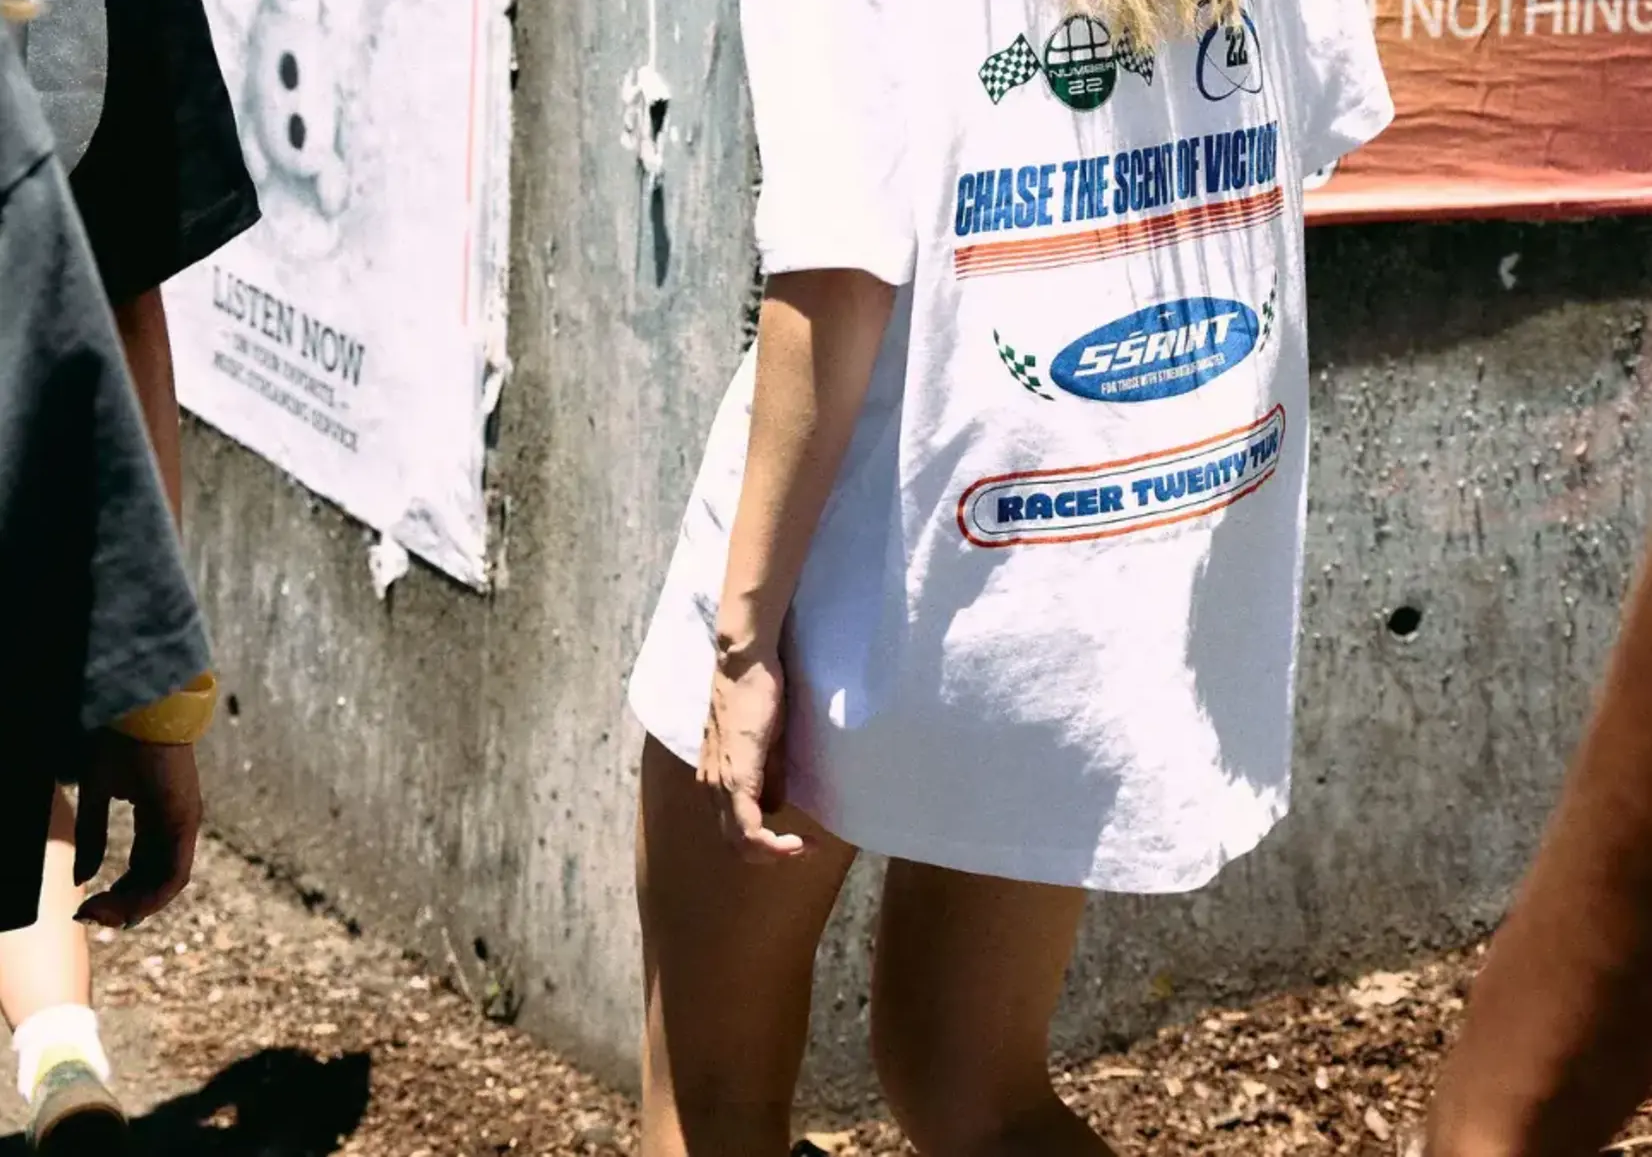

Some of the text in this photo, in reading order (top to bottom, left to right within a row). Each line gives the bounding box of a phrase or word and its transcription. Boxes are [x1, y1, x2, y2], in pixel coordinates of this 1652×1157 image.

[1225, 25, 1248, 68] 22
[1068, 77, 1103, 96] 22
[954, 163, 1057, 237] CHASE
[1062, 155, 1110, 223] THE
[1113, 142, 1175, 215] SCENT
[1177, 136, 1200, 200] OF
[213, 265, 295, 345] LISTEN
[301, 313, 366, 387] NOW
[997, 488, 1125, 524] RACER
[1131, 450, 1249, 507] TWENTY
